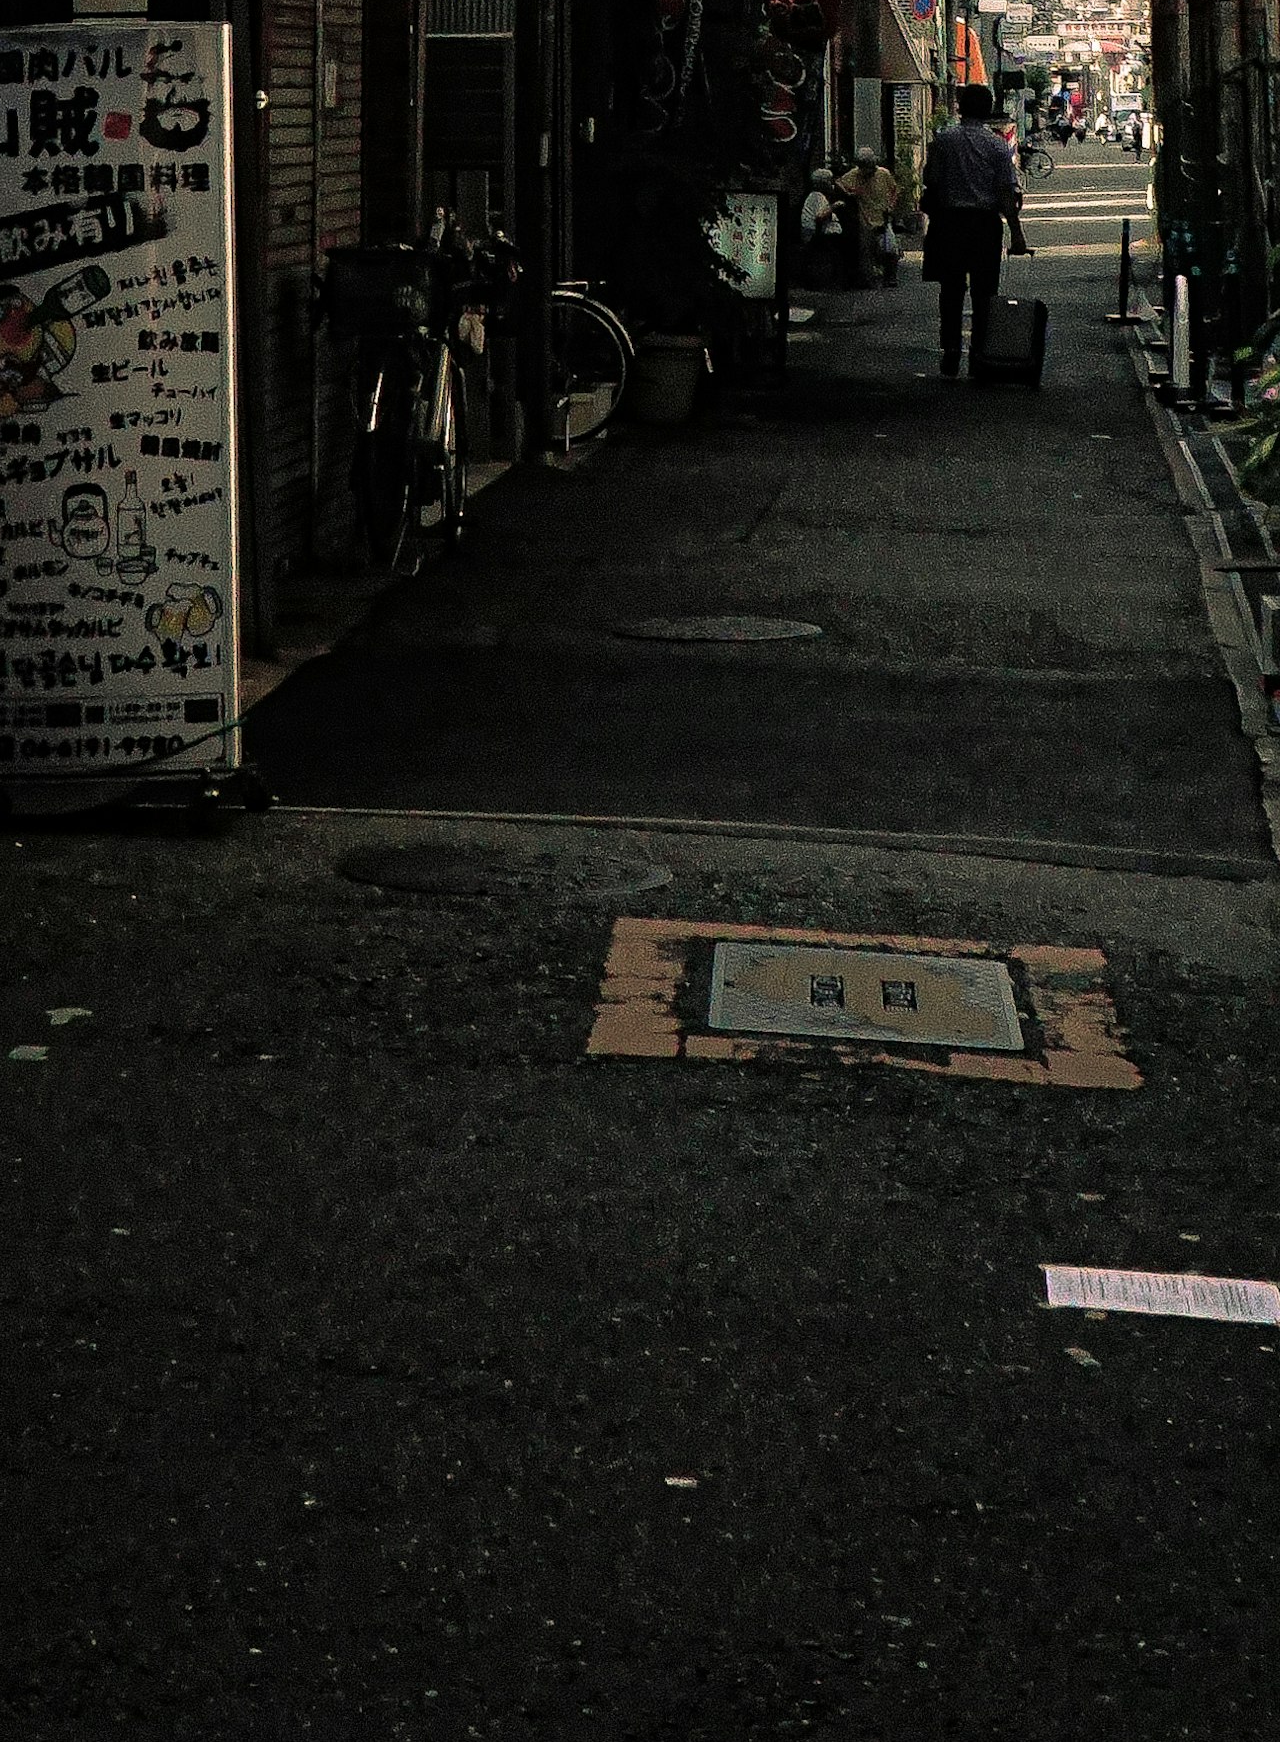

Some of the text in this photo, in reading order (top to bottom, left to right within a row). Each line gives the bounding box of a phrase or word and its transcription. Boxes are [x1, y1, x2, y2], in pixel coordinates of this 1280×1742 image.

[91, 359, 169, 384] 生ビール
[151, 382, 218, 399] チューハイ
